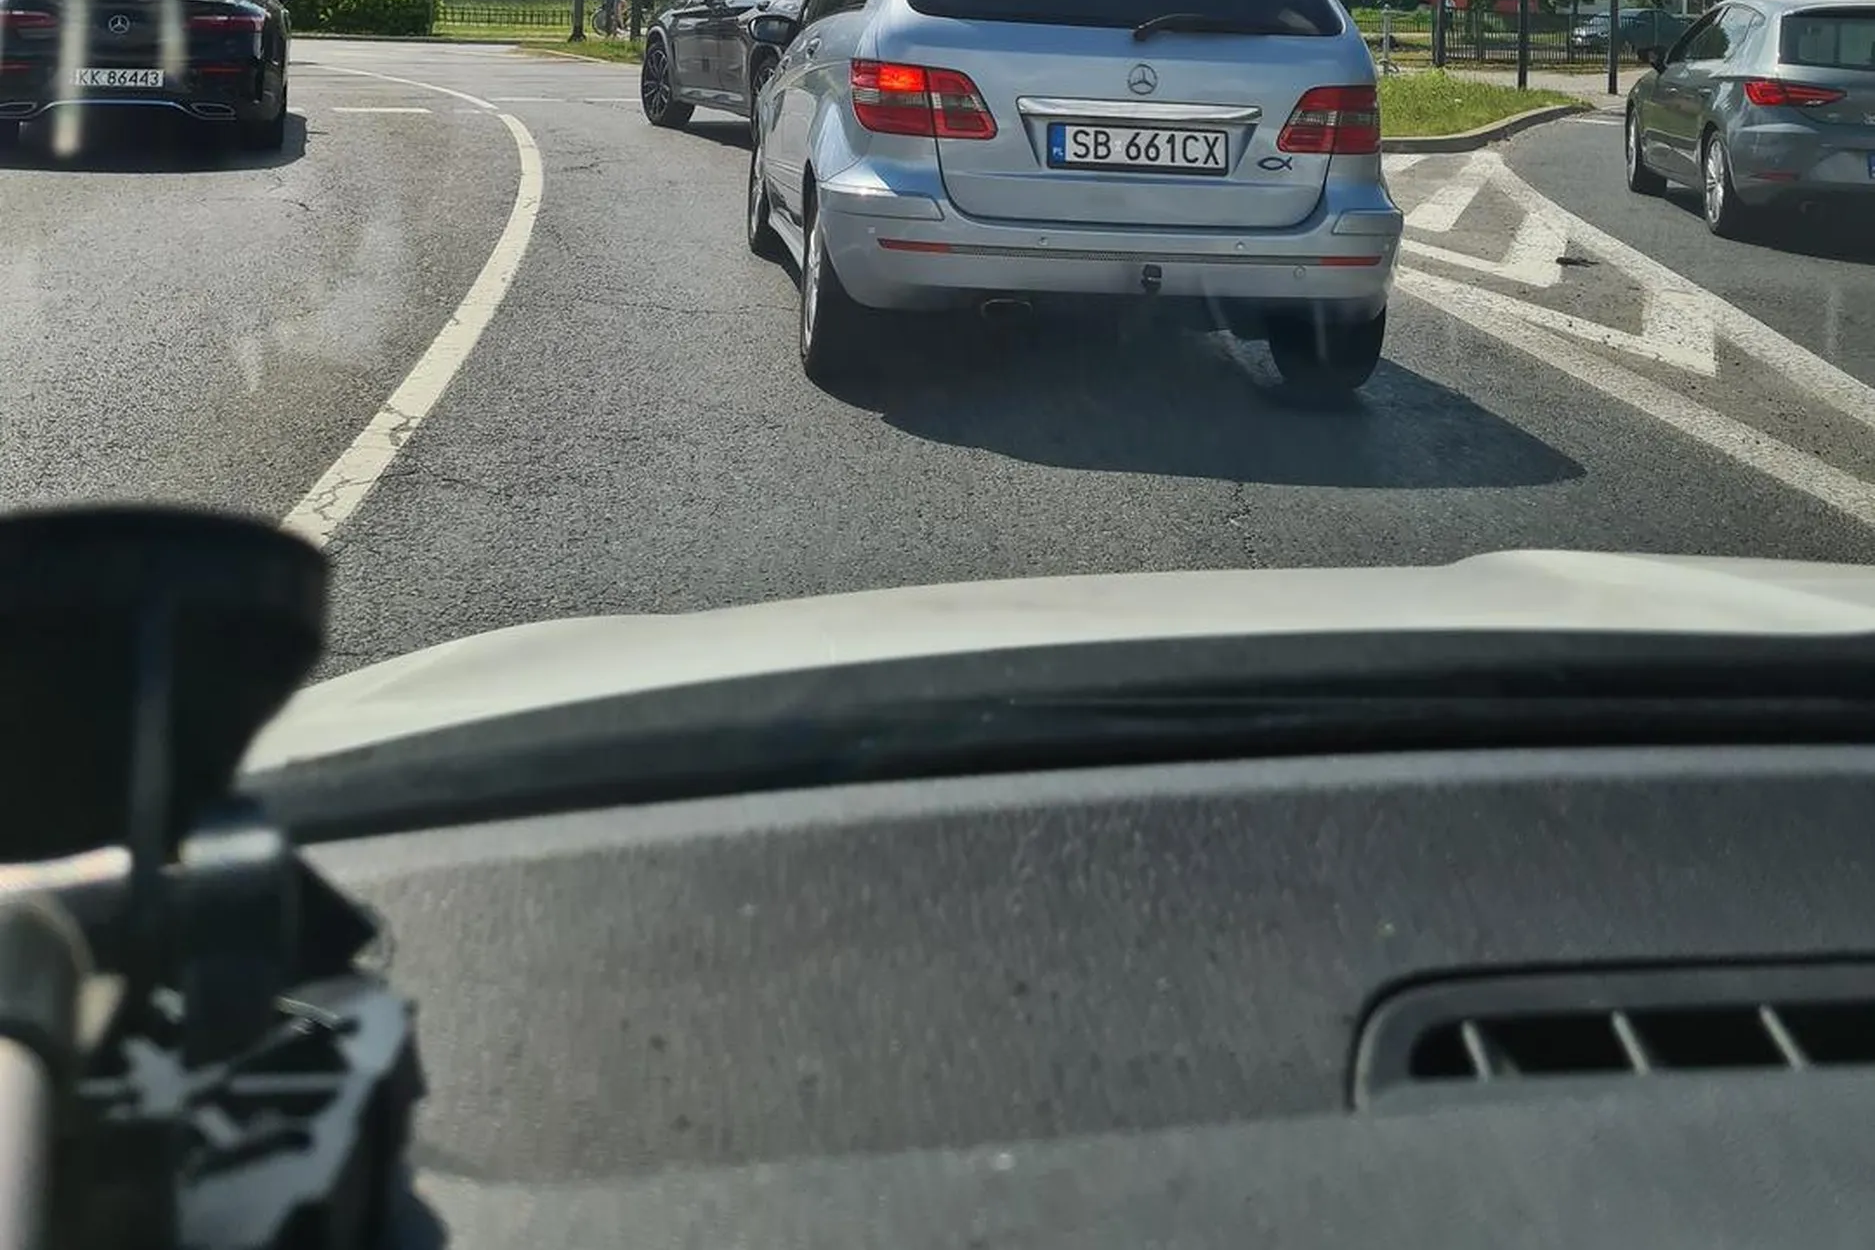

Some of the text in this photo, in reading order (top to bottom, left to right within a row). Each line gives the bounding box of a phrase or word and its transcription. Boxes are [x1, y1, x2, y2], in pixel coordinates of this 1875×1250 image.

[80, 70, 159, 86] KK 86443
[1072, 129, 1220, 166] SB 661CX
